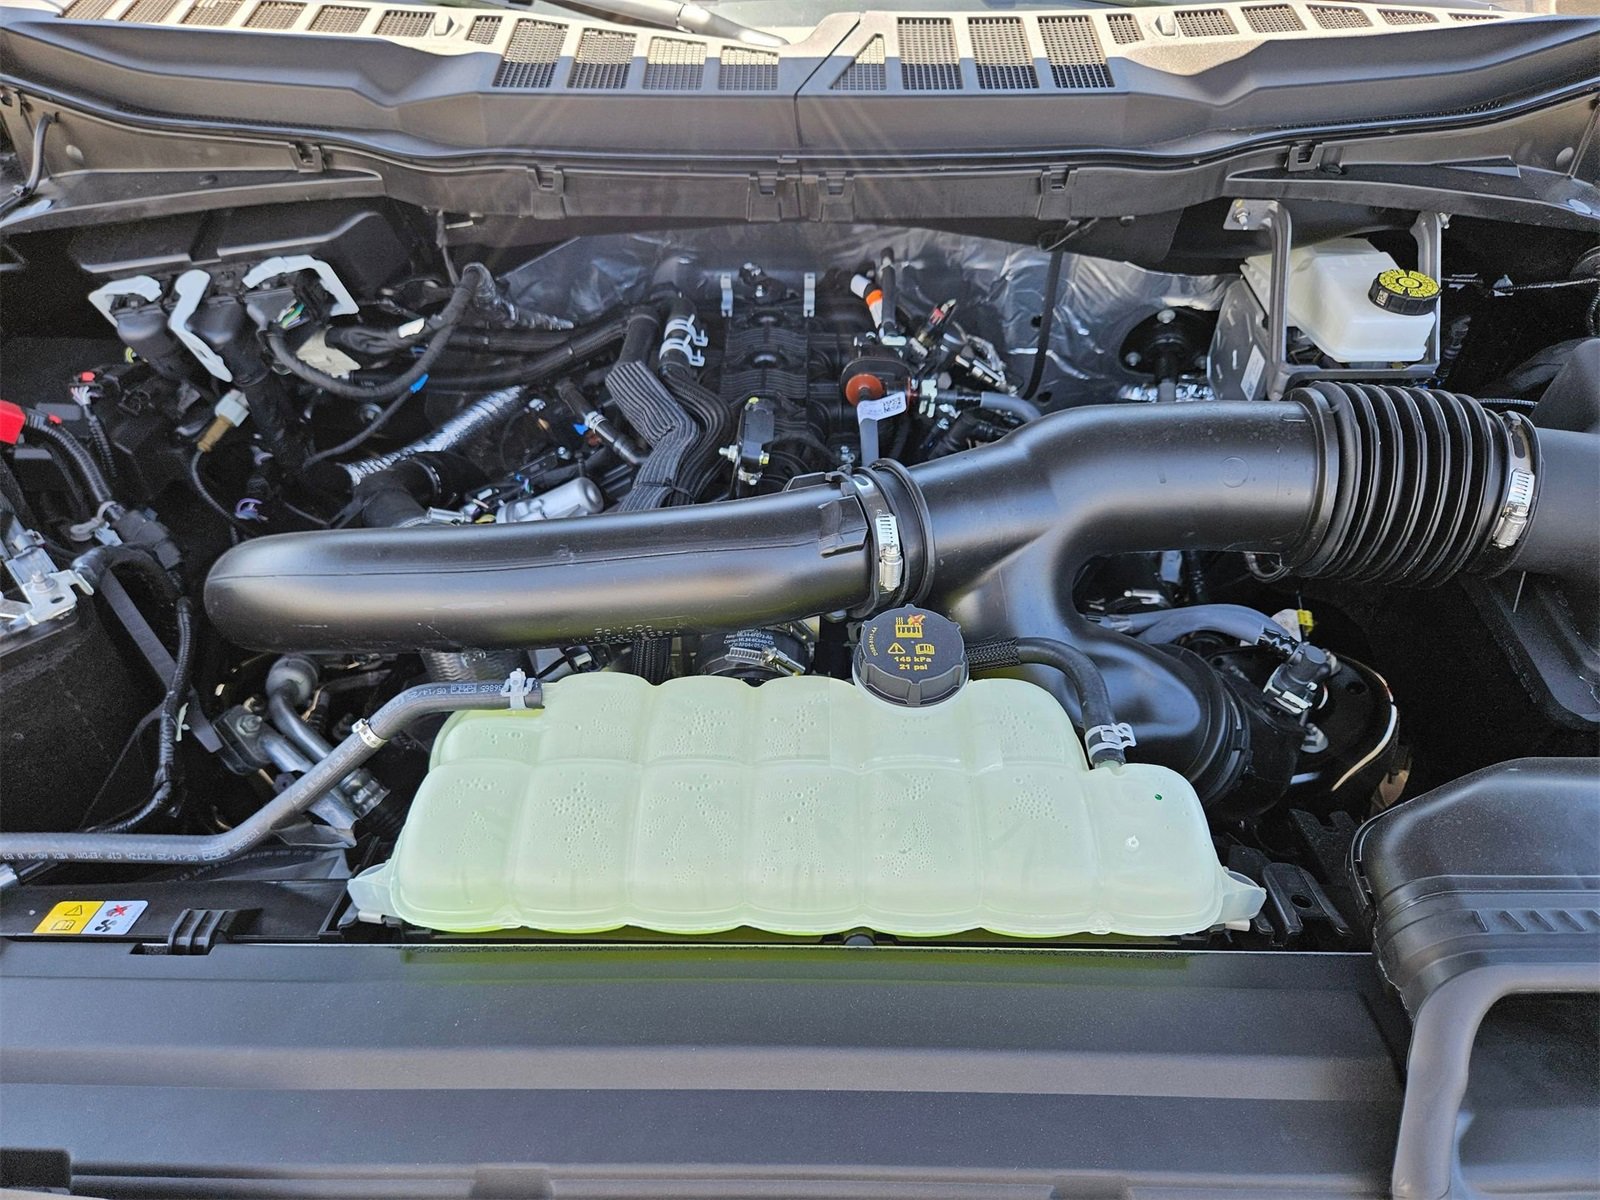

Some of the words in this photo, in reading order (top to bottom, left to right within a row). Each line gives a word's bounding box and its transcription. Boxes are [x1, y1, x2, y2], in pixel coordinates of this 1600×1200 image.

[913, 663, 928, 671] psi
[407, 687, 447, 699] 05/14/25
[480, 684, 503, 693] 36865
[157, 852, 199, 862] 05/14/25
